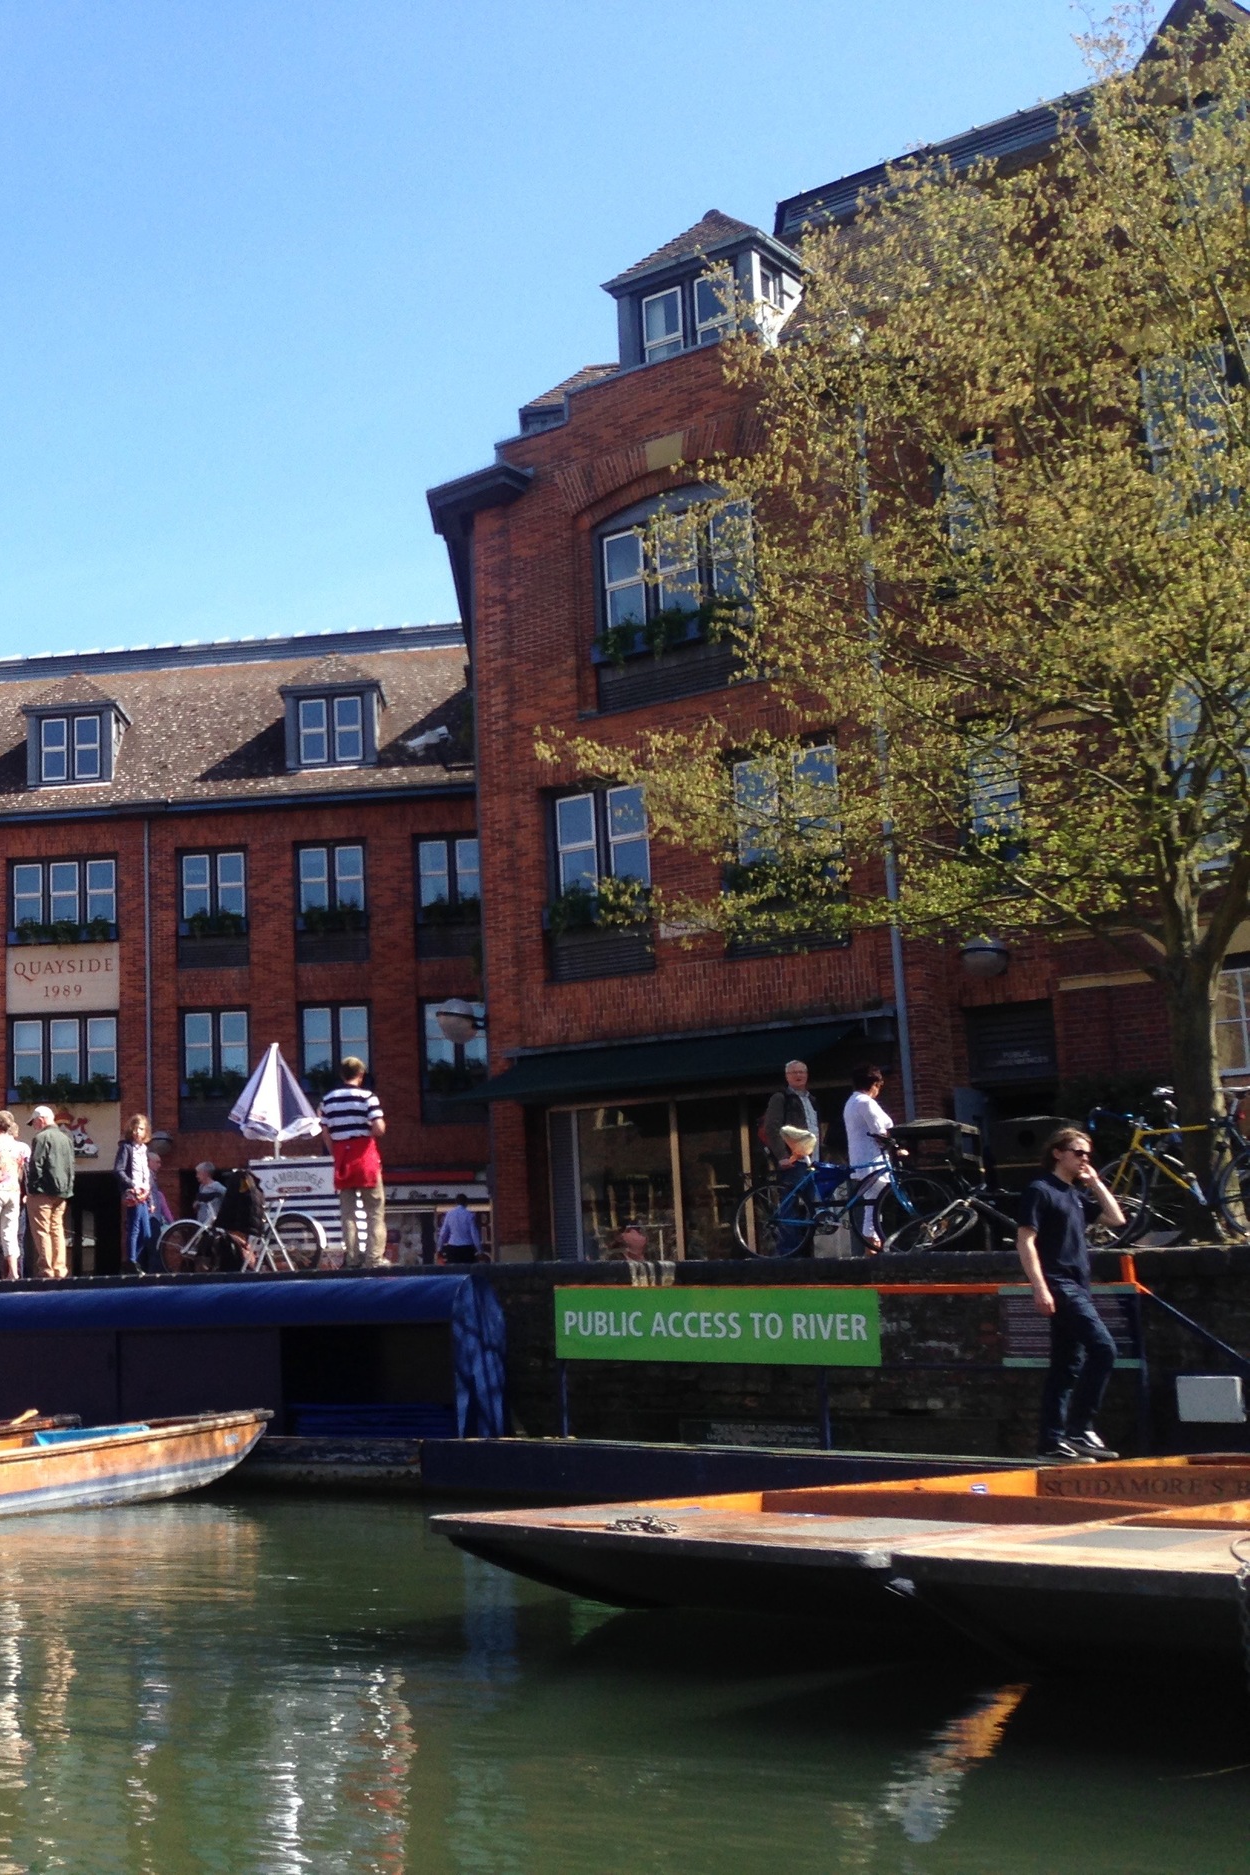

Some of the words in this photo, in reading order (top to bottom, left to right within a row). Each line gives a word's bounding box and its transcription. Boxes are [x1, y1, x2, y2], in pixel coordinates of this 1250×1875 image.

[13, 957, 114, 982] QUAYSIDE
[43, 984, 83, 998] 1989
[263, 1170, 326, 1191] CAMBRIDGE
[563, 1310, 644, 1337] PUBLIC
[650, 1311, 742, 1340] ACCESS
[749, 1312, 784, 1340] TO
[792, 1313, 869, 1341] RIVER
[1044, 1477, 1224, 1497] SCUDAMORE'S
